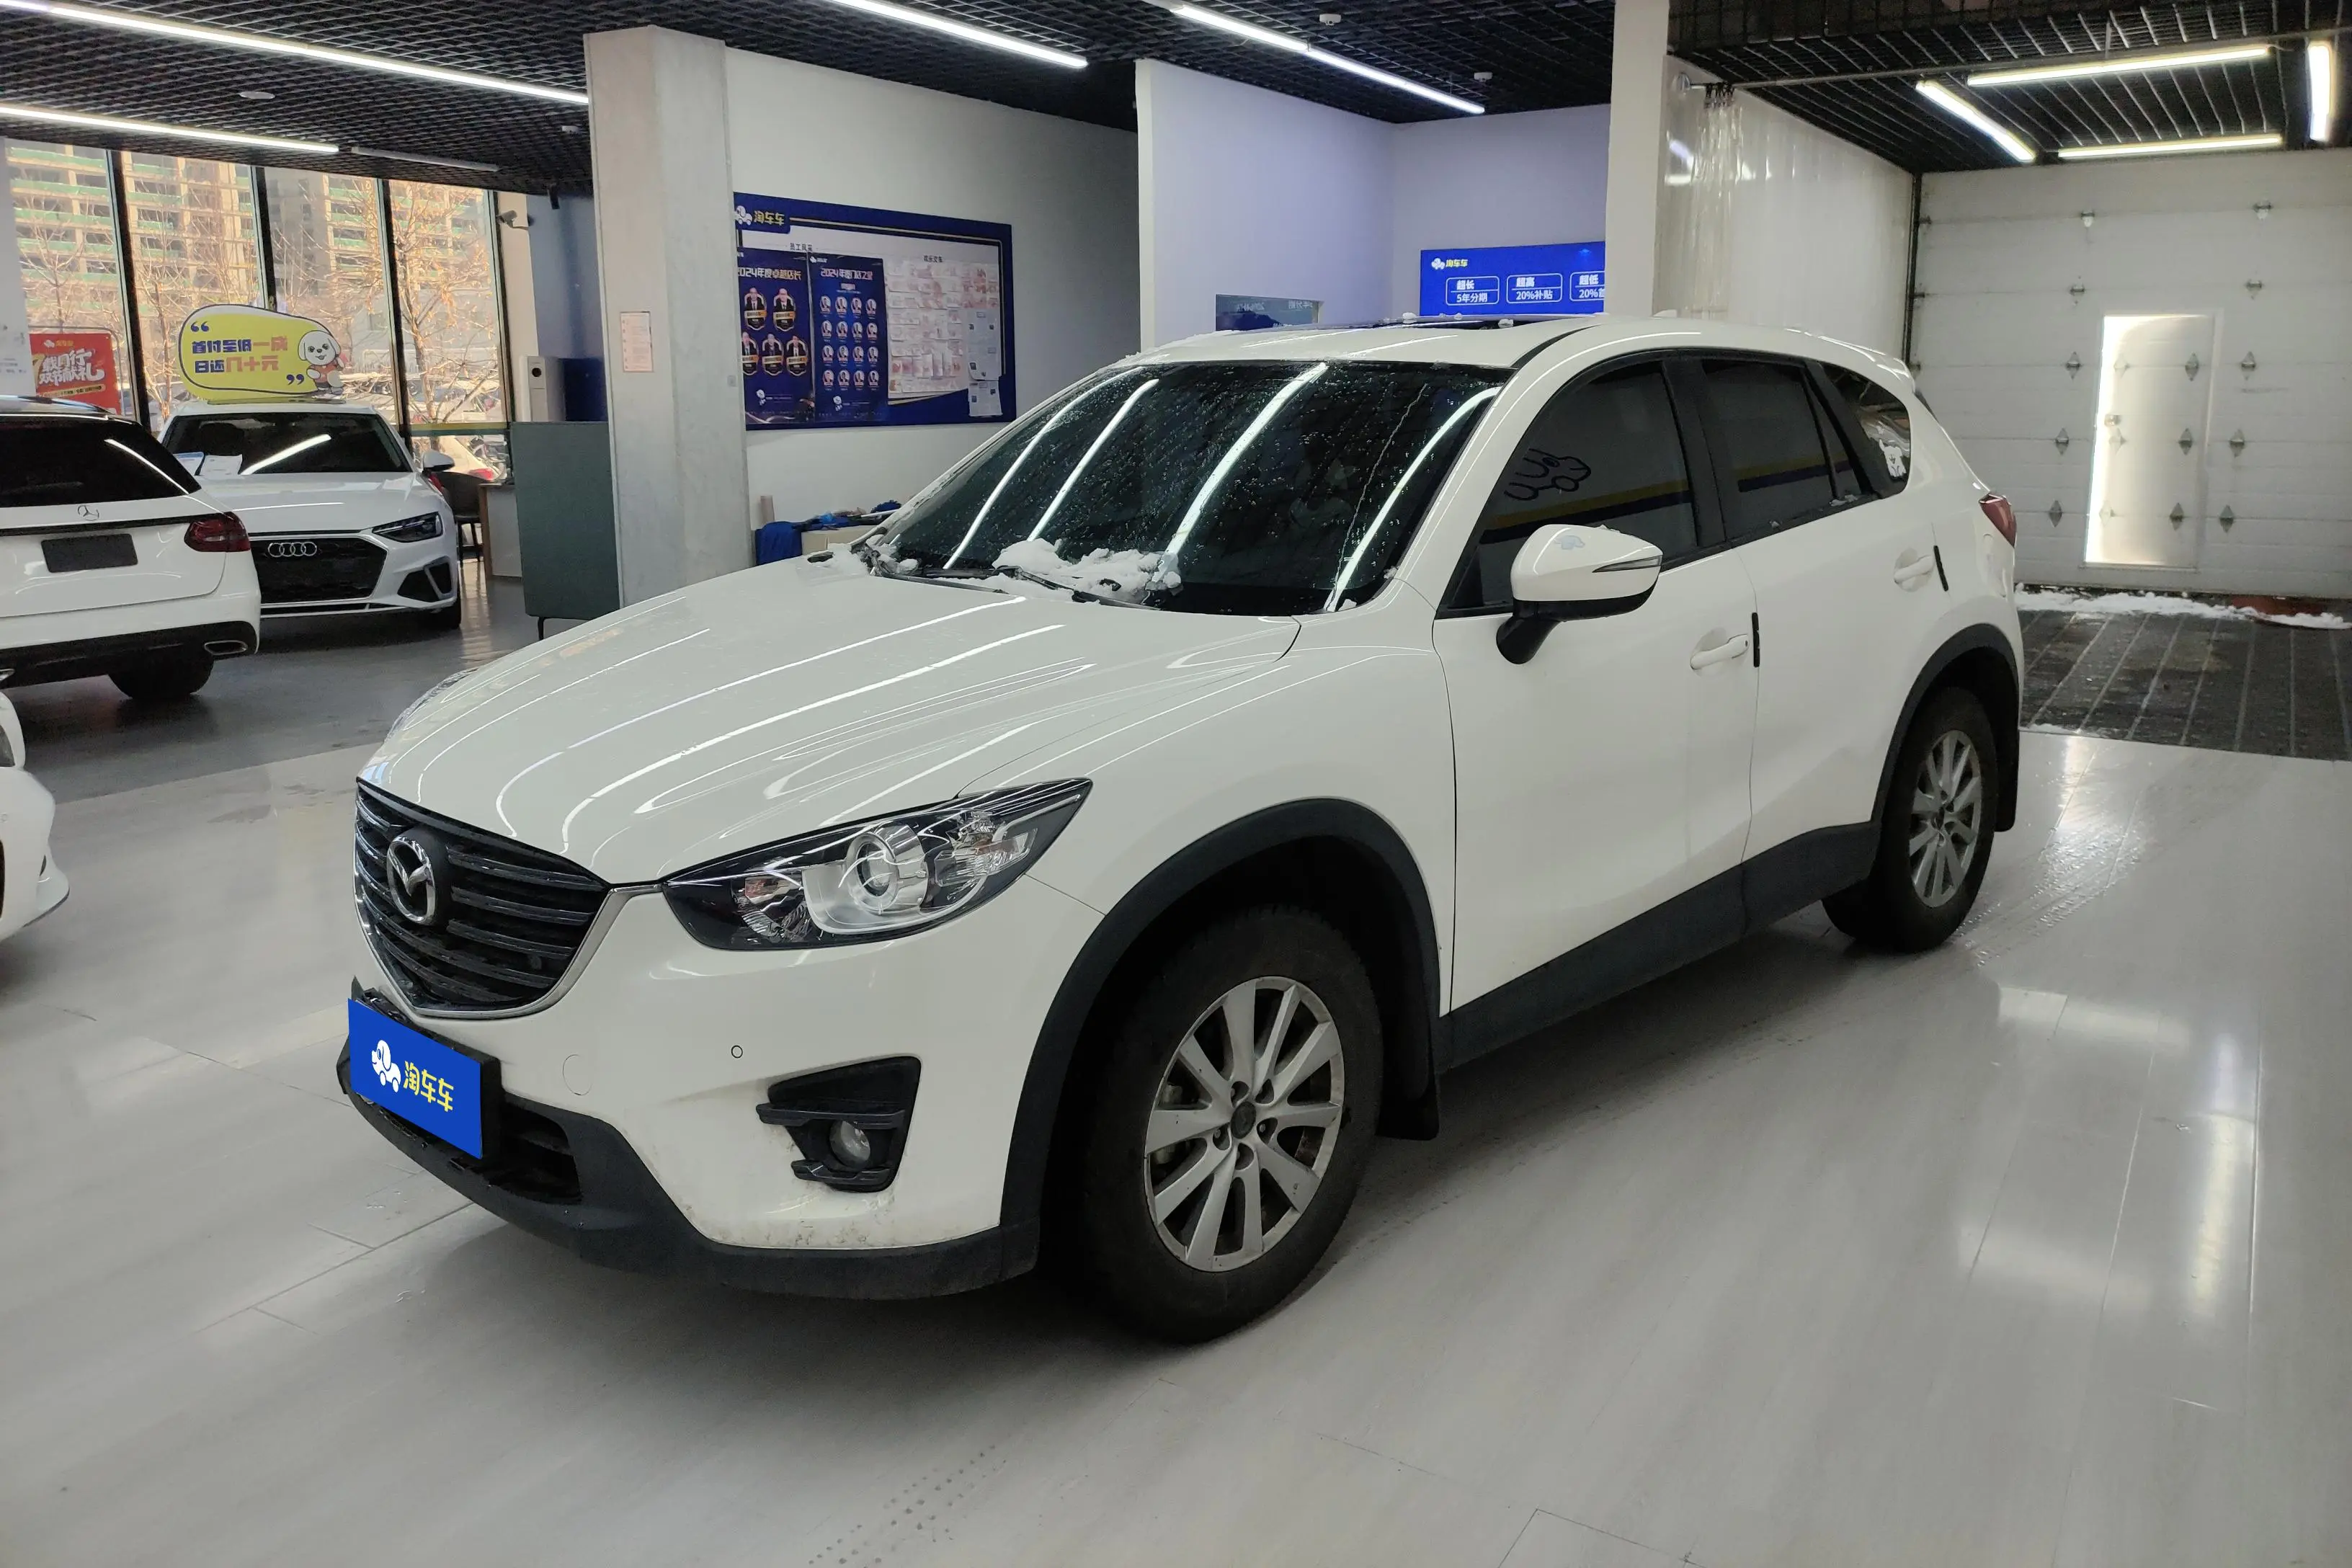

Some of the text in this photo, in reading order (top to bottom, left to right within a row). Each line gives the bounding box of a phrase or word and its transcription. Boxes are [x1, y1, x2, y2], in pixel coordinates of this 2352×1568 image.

[754, 210, 785, 226] 淘车车
[1457, 280, 1474, 290] 超长
[1516, 277, 1535, 288] 超高
[1579, 275, 1599, 285] 超低
[1456, 293, 1488, 303] 5年分期
[1516, 290, 1553, 300] 20%补贴
